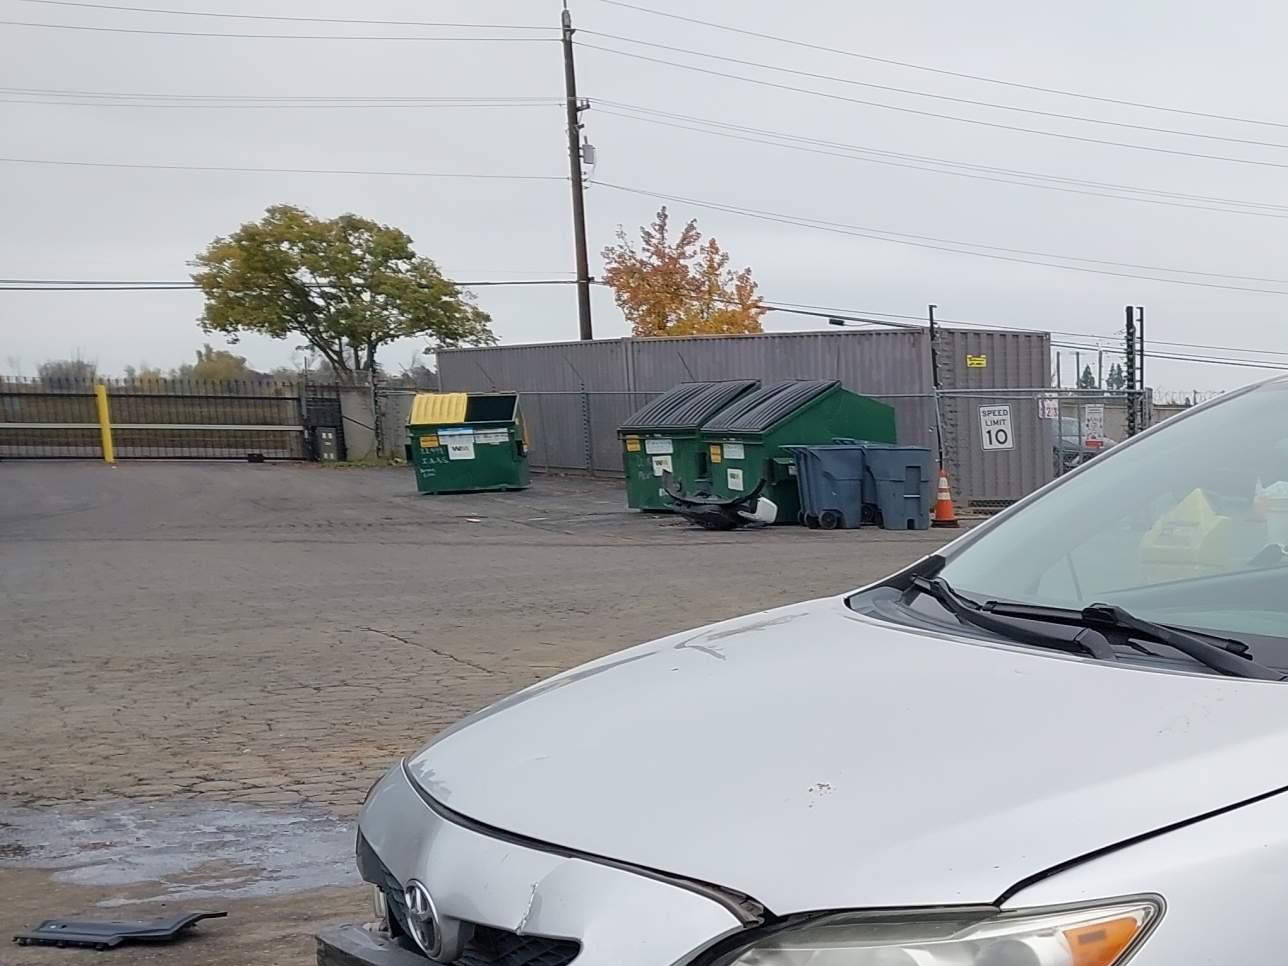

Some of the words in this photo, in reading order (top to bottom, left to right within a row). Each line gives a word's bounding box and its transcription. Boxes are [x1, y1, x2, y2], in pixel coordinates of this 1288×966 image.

[981, 409, 1009, 417] SPEED
[985, 419, 1007, 427] LIMIT
[985, 428, 1008, 446] 10
